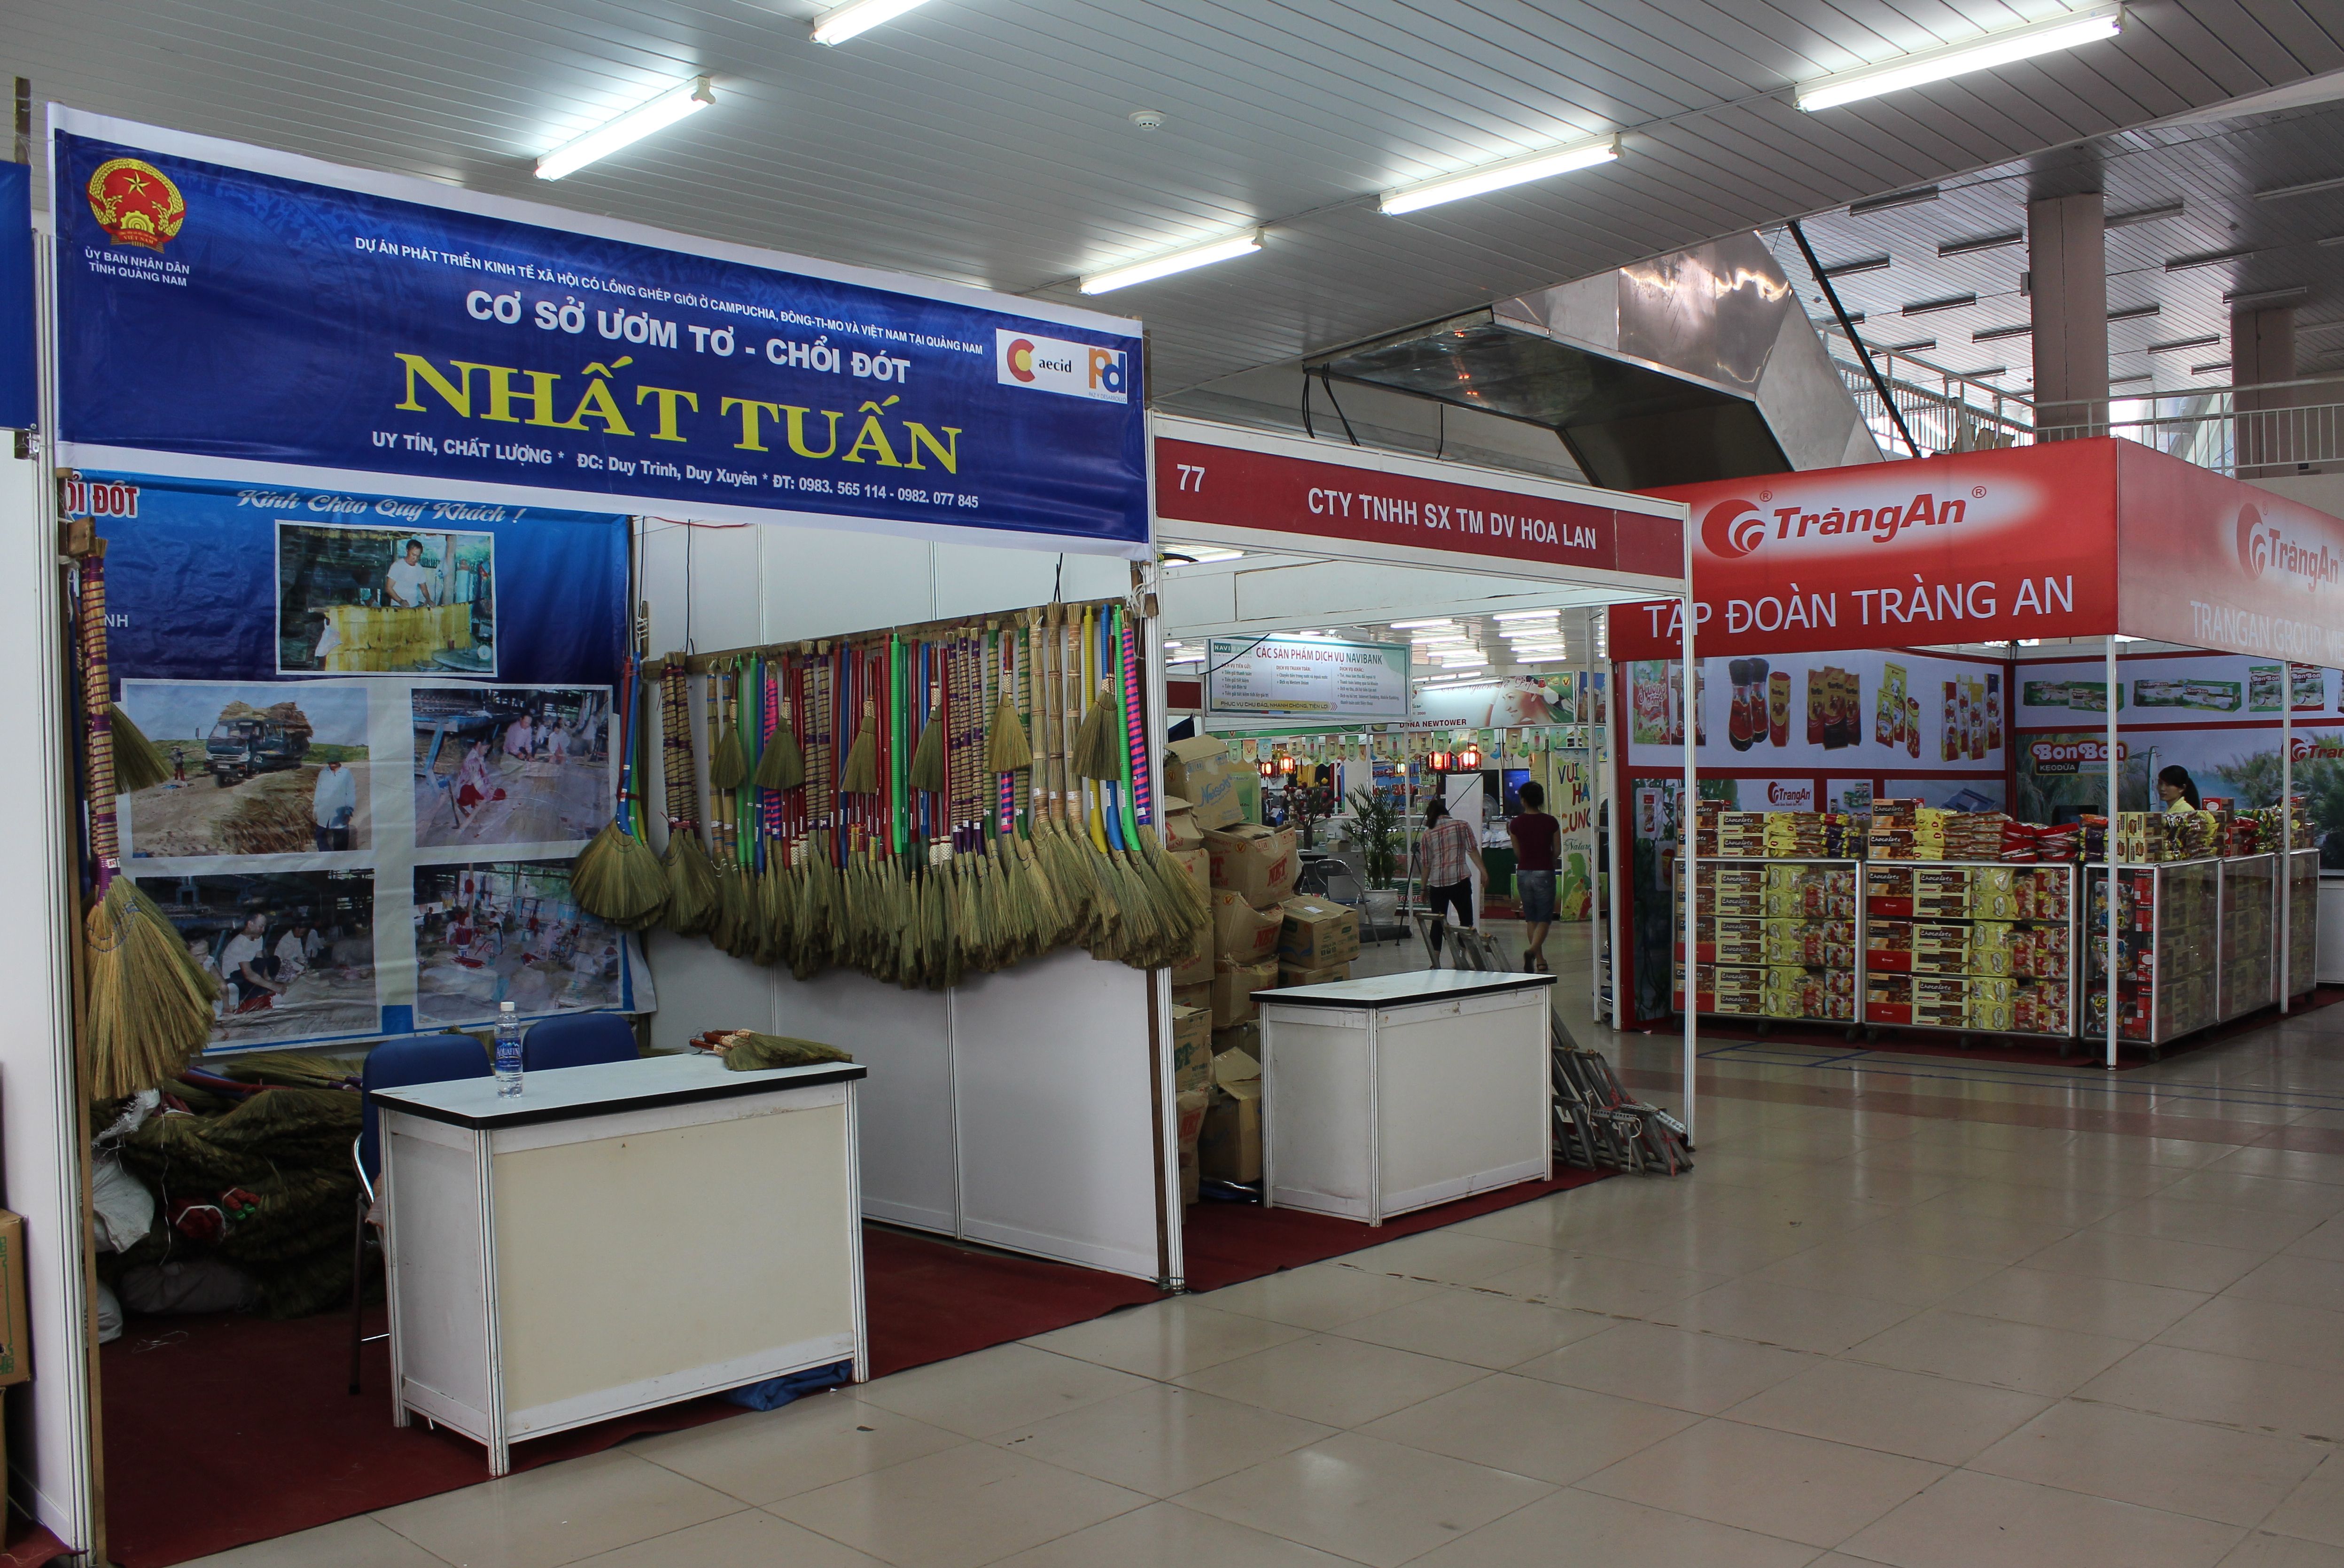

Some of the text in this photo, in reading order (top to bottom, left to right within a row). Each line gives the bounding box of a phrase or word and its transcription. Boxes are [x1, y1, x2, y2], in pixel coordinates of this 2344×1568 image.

[85, 246, 189, 274] ỦY BAN NHÂN DÂN
[88, 260, 187, 287] TỈNH QUẢNG NAM
[355, 237, 983, 355] DỰ ÁN PHÁT TRIỂN KINH TẾ XÃ HỘI CÓ LỒNG GHÉP GIỚI Ở CAMPUCHIA, ĐÔNG-TI-MO VÀ VIỆT NAM TẠI QUẢNG NAM
[466, 290, 522, 325] CƠ
[535, 296, 586, 334] SỞ
[598, 307, 677, 349] ƯƠM
[688, 325, 735, 357] TƠ
[766, 335, 840, 374] CHỔI
[850, 350, 911, 384] ĐÓT
[1039, 359, 1072, 373] aecid
[394, 352, 962, 475] NHẤT TUẤN
[1100, 394, 1127, 403] DESARROLLO
[372, 431, 398, 448] UY
[403, 432, 438, 456] TÍN,
[444, 438, 490, 458] CHẤT
[496, 443, 552, 466] LƯỢNG
[577, 453, 603, 470] ĐC:
[608, 456, 636, 476] Duy
[640, 460, 681, 481] Trinh,
[686, 465, 712, 484] Duy
[716, 468, 757, 488] Xuyên
[772, 474, 795, 490] ĐT:
[799, 476, 833, 494] 0983.
[837, 481, 860, 496] 565
[864, 484, 886, 499] 114
[897, 487, 930, 504] 0982.
[933, 491, 955, 506] 077
[957, 494, 979, 508] 845
[1176, 463, 1205, 492] 77
[93, 480, 137, 515] ĐÓT
[237, 490, 300, 508] Kính
[307, 495, 368, 515] Chào
[375, 499, 428, 522] Quý
[432, 503, 506, 523] Khách
[1308, 487, 1596, 550] CTY TNHH SX TM DV HOA LAN
[1773, 493, 1966, 543] TràngAn
[1725, 583, 1836, 634] ĐOÀN
[1851, 573, 1997, 625] TRÀNG
[2013, 575, 2073, 616] AN
[2190, 601, 2270, 650] TRANGAN
[2274, 618, 2321, 657] GROUP
[1256, 645, 1382, 665] CÁC SẢN PHẨM DỊCH VỤ NAVIBANK
[1423, 719, 1466, 727] NEWTOWER
[1558, 763, 1580, 784] VUI
[1920, 928, 1952, 937] Chocolate
[1920, 982, 1951, 990] Chocolate
